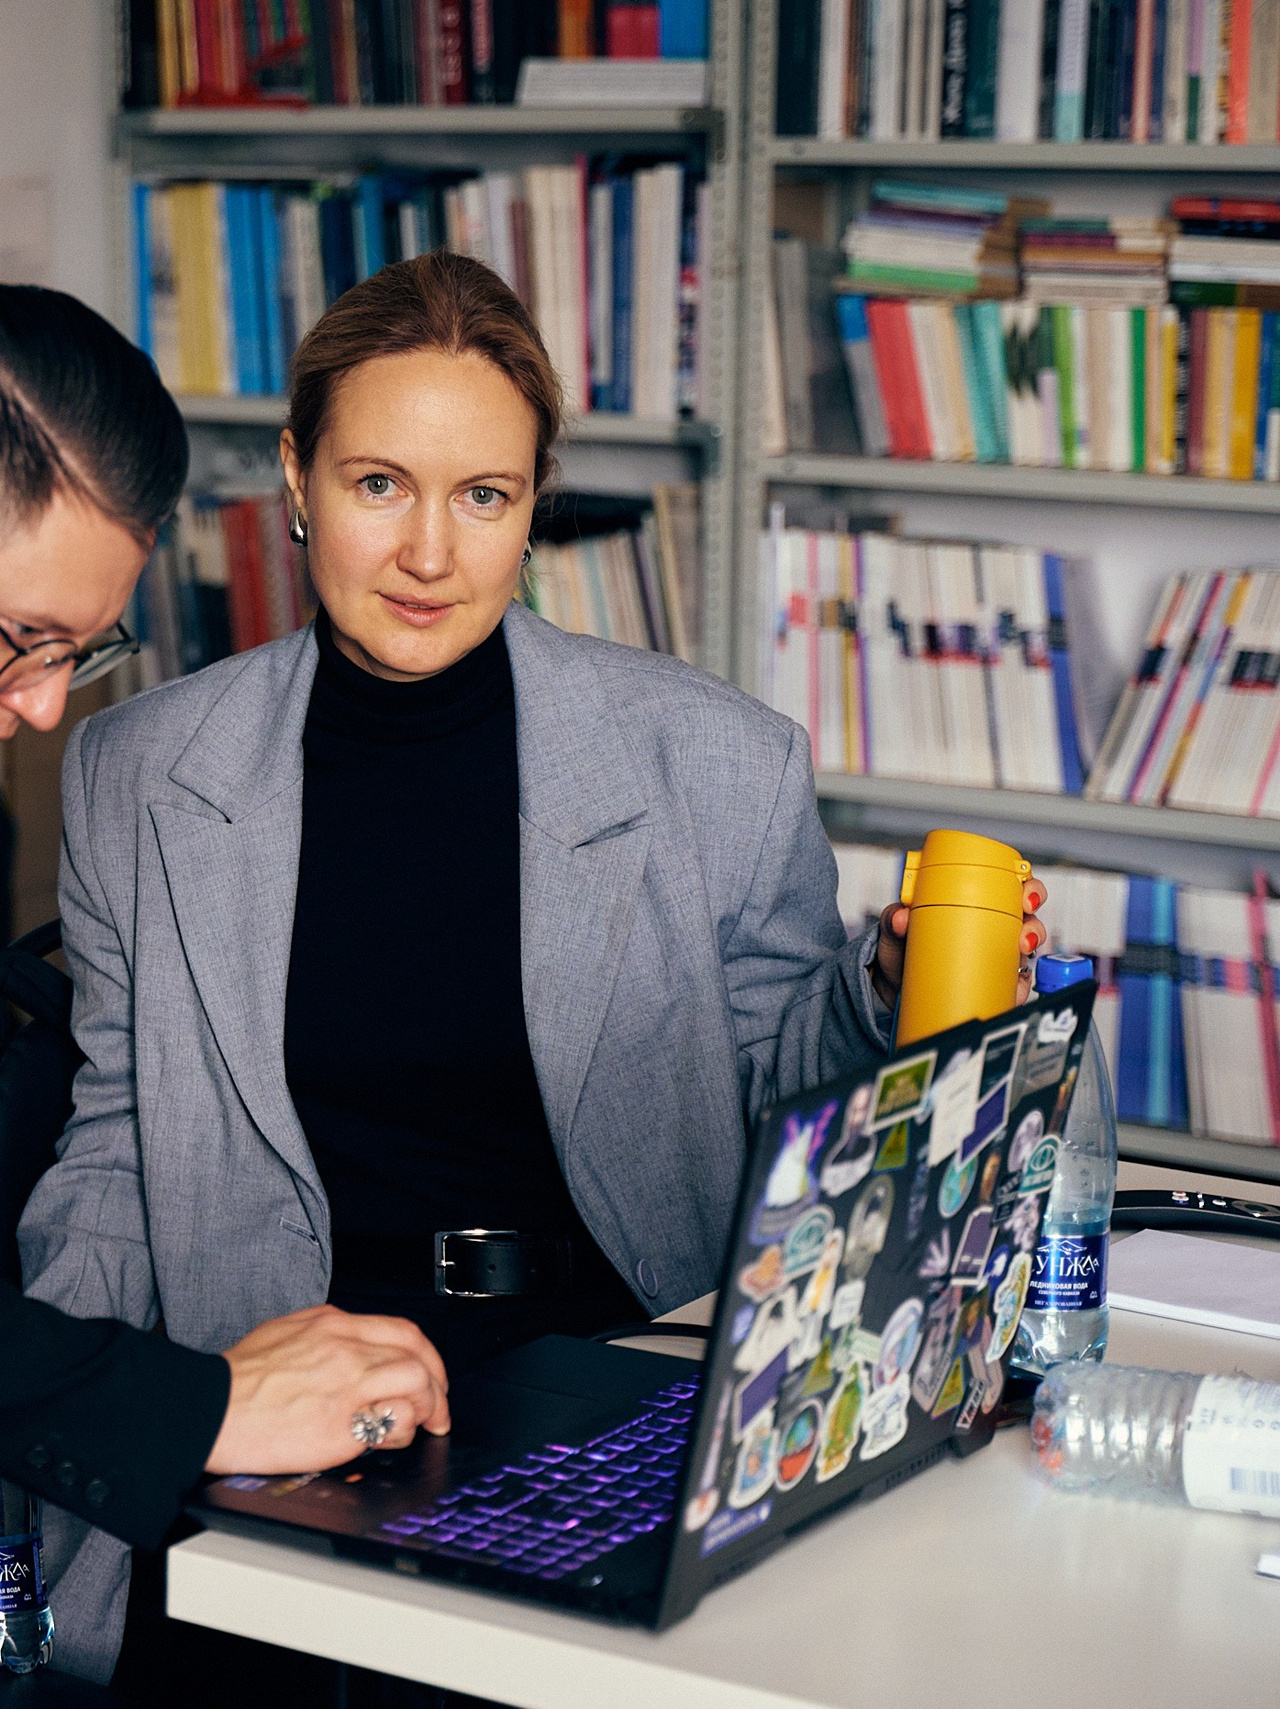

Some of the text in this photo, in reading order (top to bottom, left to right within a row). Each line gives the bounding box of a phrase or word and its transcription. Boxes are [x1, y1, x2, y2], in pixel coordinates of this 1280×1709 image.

[1031, 1255, 1099, 1276] УНЖА
[1073, 1282, 1088, 1290] ВОДА
[6, 1586, 21, 1594] ВОДА
